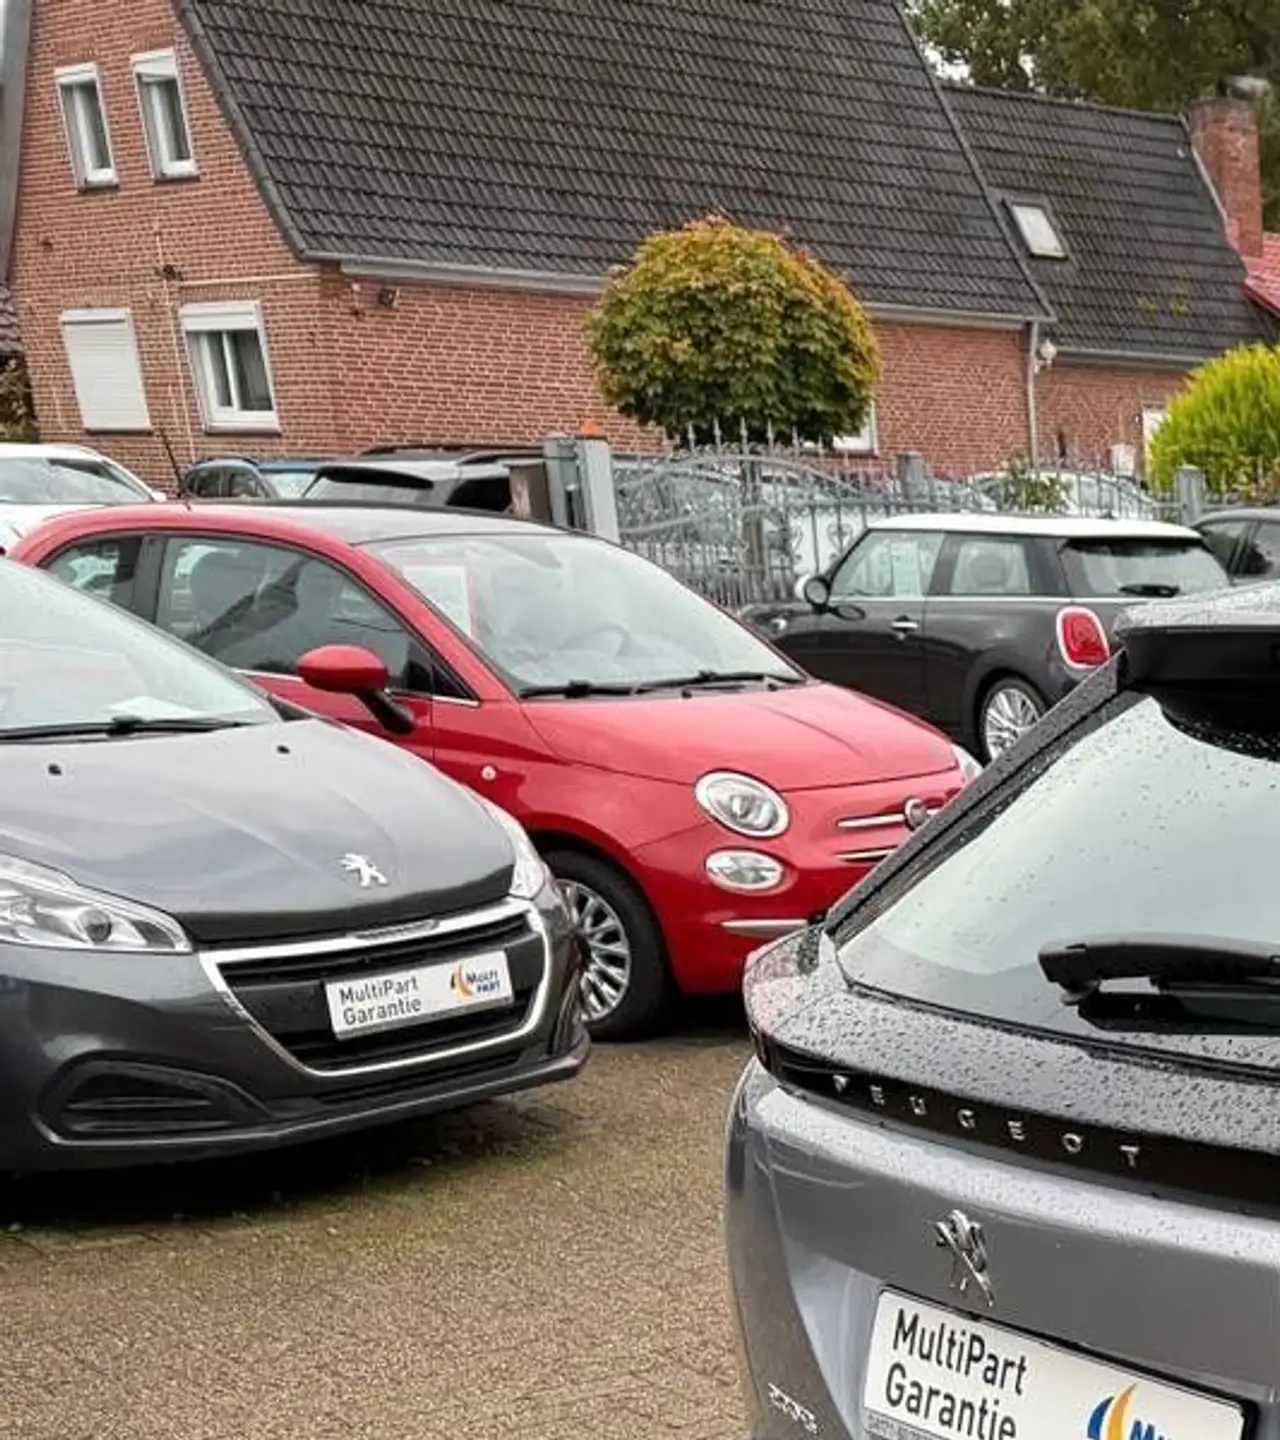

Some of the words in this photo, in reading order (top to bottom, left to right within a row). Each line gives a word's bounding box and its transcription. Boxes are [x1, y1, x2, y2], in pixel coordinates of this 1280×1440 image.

[338, 975, 420, 1006] MultiPart
[342, 996, 422, 1026] Garantie
[833, 1074, 1140, 1168] PEUGEOT
[892, 1308, 1027, 1396] MultiPart
